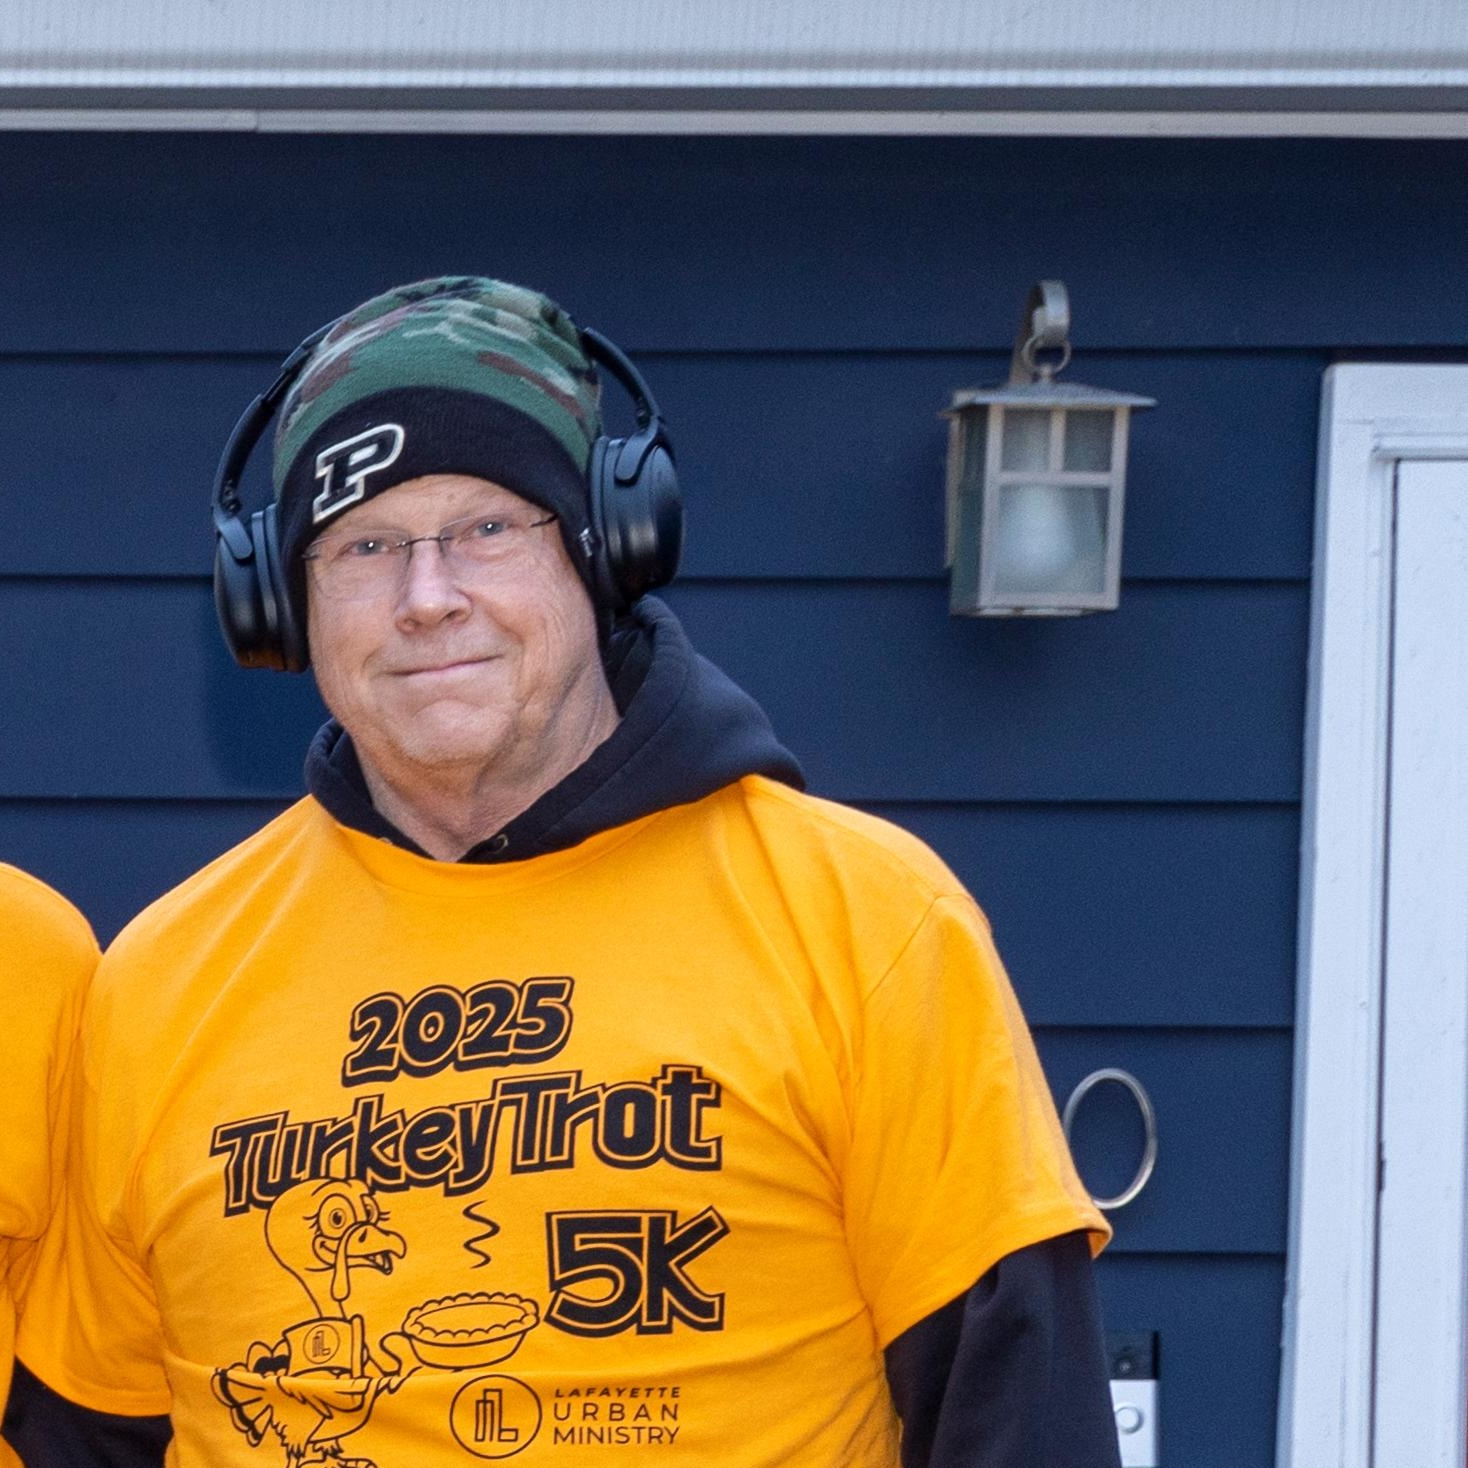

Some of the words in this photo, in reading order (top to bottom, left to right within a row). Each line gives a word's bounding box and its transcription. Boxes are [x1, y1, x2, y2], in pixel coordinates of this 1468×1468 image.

[342, 976, 574, 1087] 2025
[544, 1205, 730, 1338] 5K
[554, 1387, 680, 1398] LAFAYETTE
[553, 1402, 679, 1421] URBAN
[553, 1426, 680, 1444] MINISTRY
